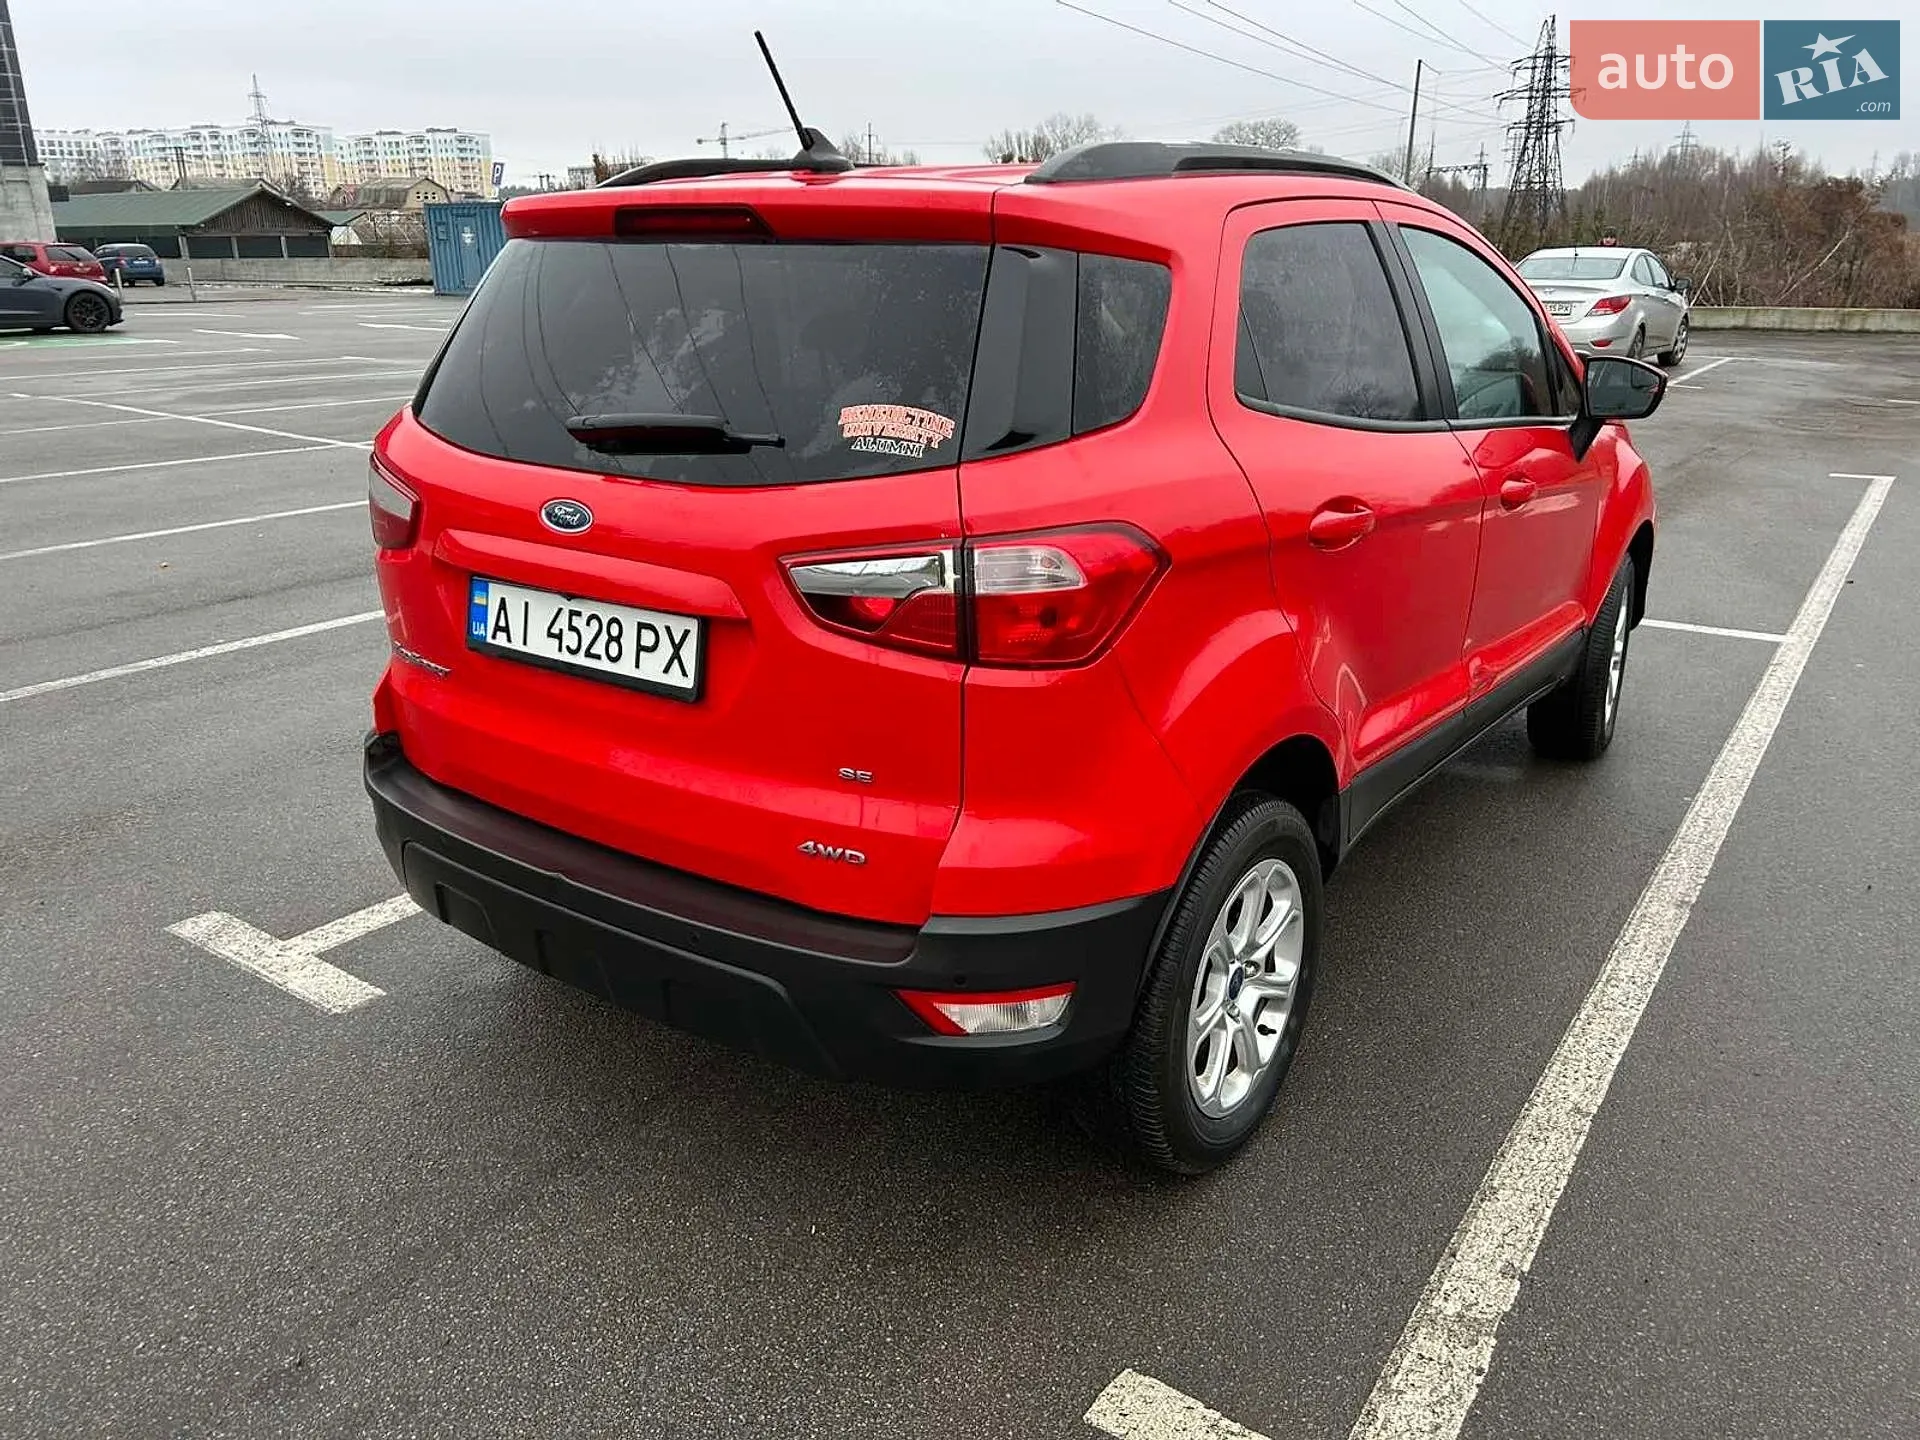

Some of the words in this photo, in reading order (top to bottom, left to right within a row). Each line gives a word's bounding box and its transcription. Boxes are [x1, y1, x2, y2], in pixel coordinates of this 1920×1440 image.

[843, 421, 943, 449] UNIVERSITY
[851, 437, 925, 458] ALUMNI
[549, 504, 581, 526] Ford
[472, 621, 486, 637] UA
[491, 597, 529, 646] AI
[546, 607, 624, 663] 4528
[635, 621, 691, 678] PX
[838, 767, 873, 783] SE
[797, 840, 866, 864] 4WD
